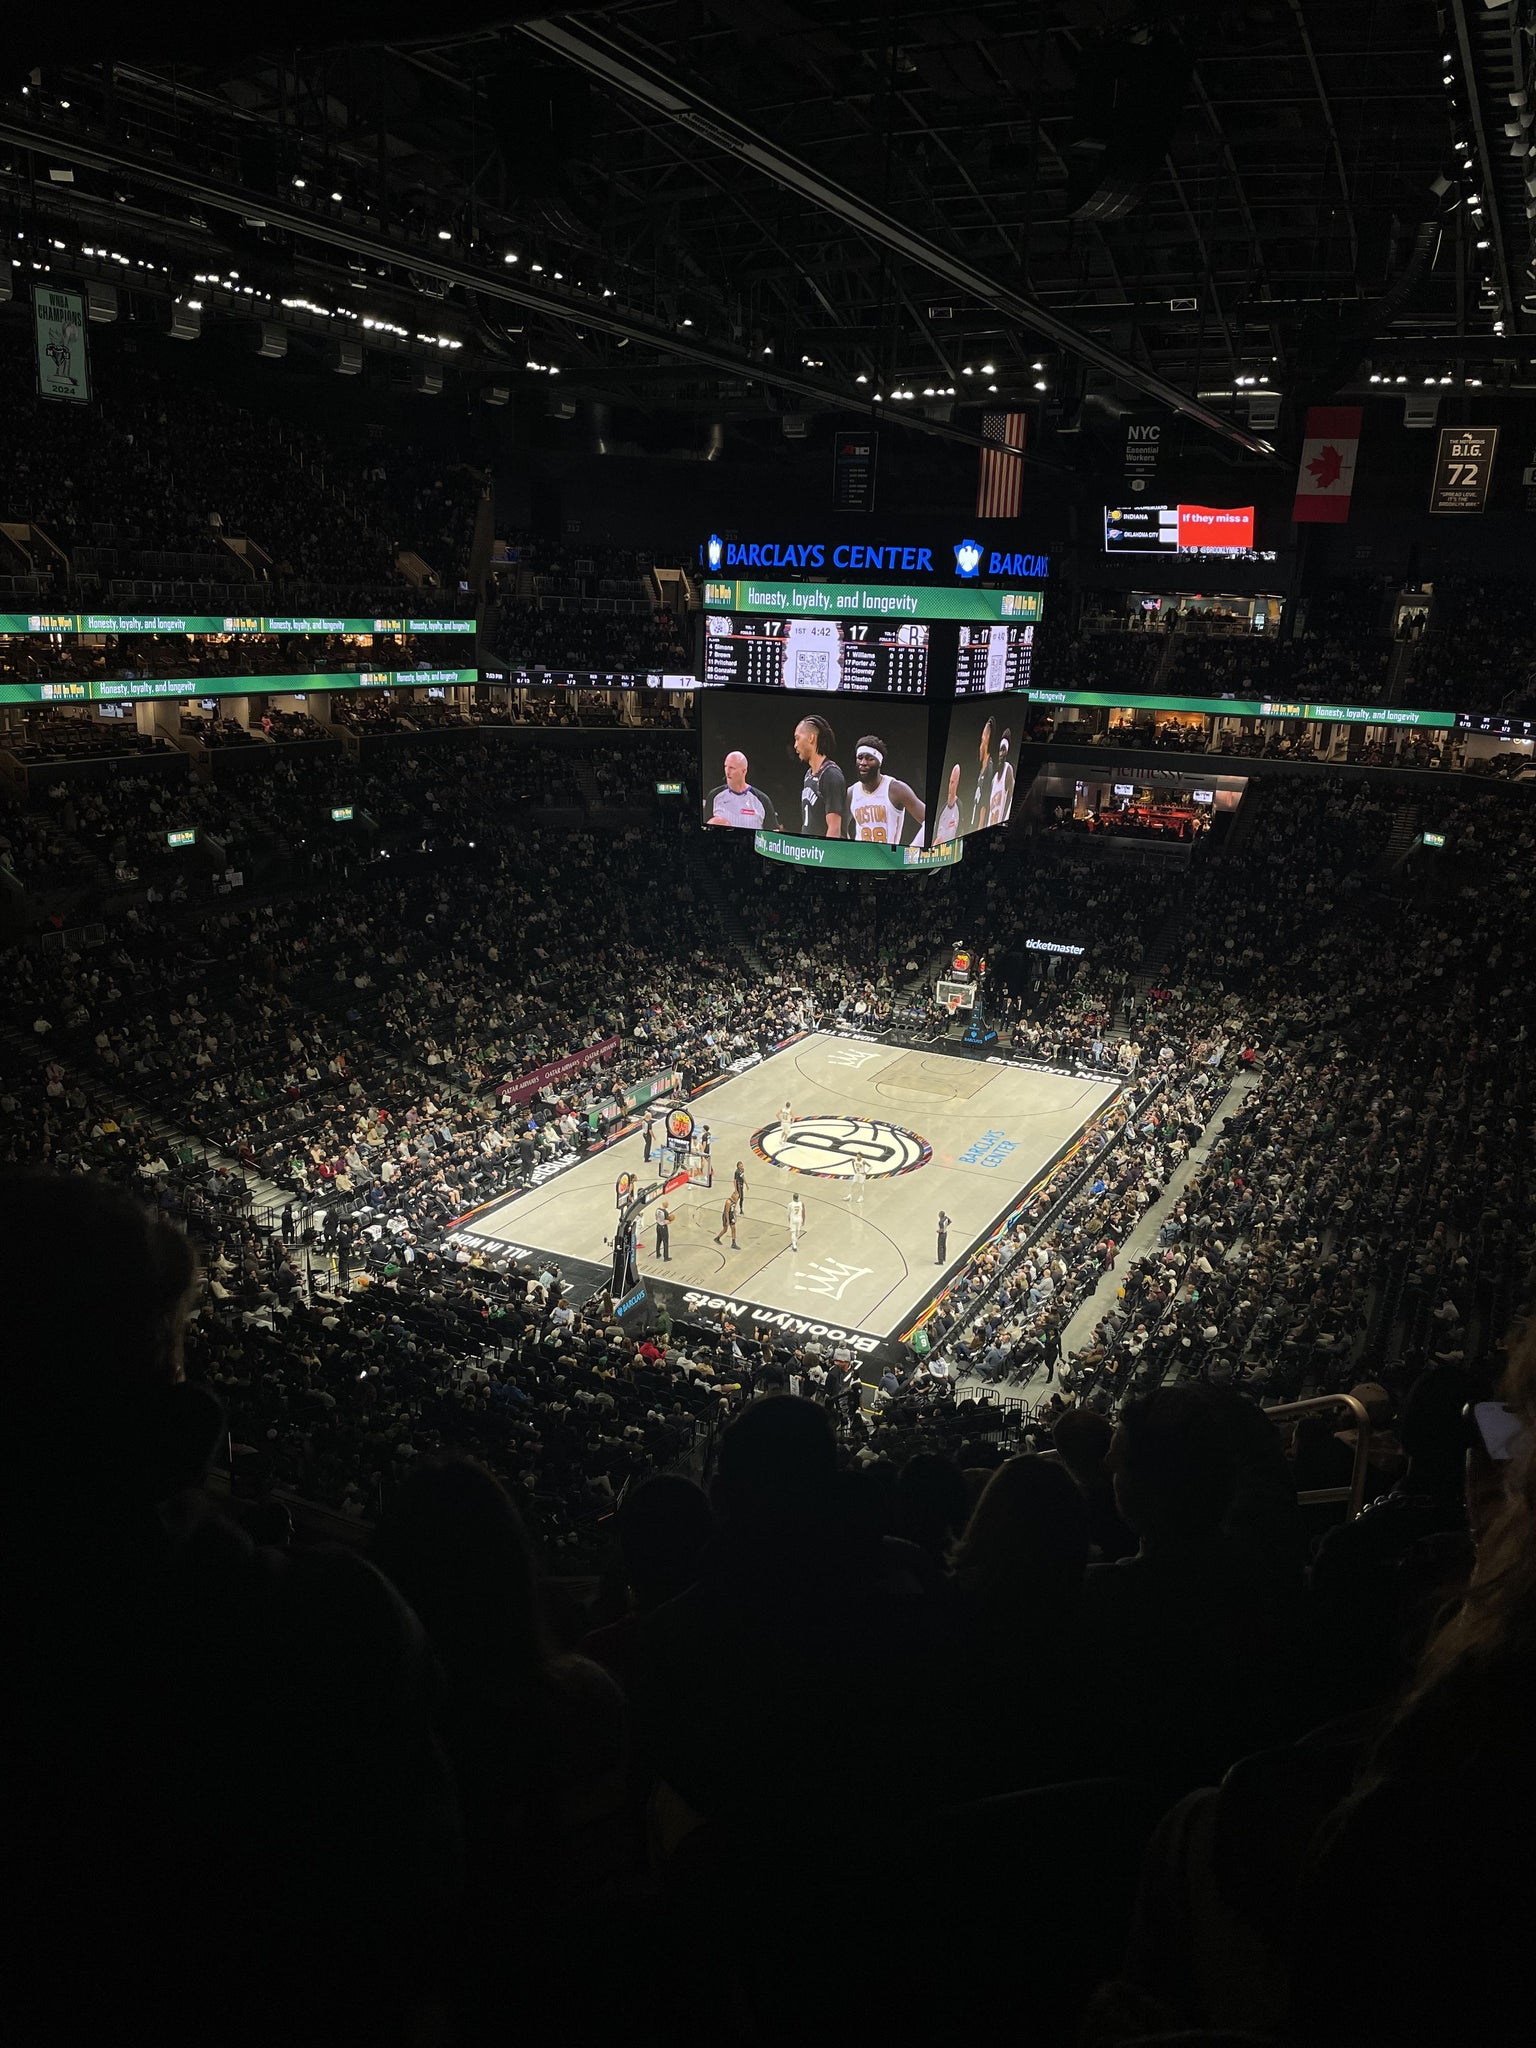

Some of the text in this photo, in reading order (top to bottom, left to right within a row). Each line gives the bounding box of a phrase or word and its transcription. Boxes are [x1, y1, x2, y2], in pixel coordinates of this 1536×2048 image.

[38, 304, 82, 327] CHAMPIONS
[52, 386, 76, 395] 2024
[1128, 426, 1160, 440] NYC
[1452, 445, 1482, 456] B.I.G.
[1448, 464, 1478, 485] 72
[1182, 514, 1190, 522] If
[1192, 514, 1214, 525] they
[1216, 514, 1240, 523] miss
[727, 544, 934, 571] BARCLAYS CENTER
[748, 587, 789, 608] Honesty,
[792, 589, 832, 610] loyalty,
[837, 591, 858, 608] and
[862, 592, 918, 614] longevity
[144, 618, 156, 628] and
[157, 618, 186, 630] longevity
[313, 621, 322, 630] and
[322, 620, 344, 632] longevity
[452, 621, 470, 631] longevity
[764, 621, 781, 636] 17
[811, 627, 831, 636] 4:42
[850, 625, 868, 640] 17
[981, 629, 1017, 643] 17 17
[438, 672, 458, 682] longevity
[680, 678, 691, 686] 17
[155, 682, 167, 692] and
[168, 681, 196, 693] longevity
[1029, 691, 1066, 702] and longevity
[1373, 710, 1386, 720] and
[1387, 710, 1419, 723] longevity
[855, 805, 887, 825] BOSTON
[769, 838, 825, 862] and longevity
[1026, 939, 1085, 955] ticketmaster
[856, 1034, 878, 1042] WON
[584, 1041, 617, 1062] QATAR AIRWAYS
[544, 1059, 580, 1079] QATAR AIRWAYS
[985, 1056, 1122, 1084] Brooklyn Nets
[501, 1077, 540, 1096] QATAR AIRWAYS
[958, 1129, 1006, 1164] BARCLAYS
[980, 1140, 1022, 1168] CENTER
[480, 1241, 504, 1253] IN
[502, 1246, 533, 1260] ALL
[622, 1289, 646, 1312] BARCLAYS
[682, 1291, 880, 1353] Brooklyn Nets
